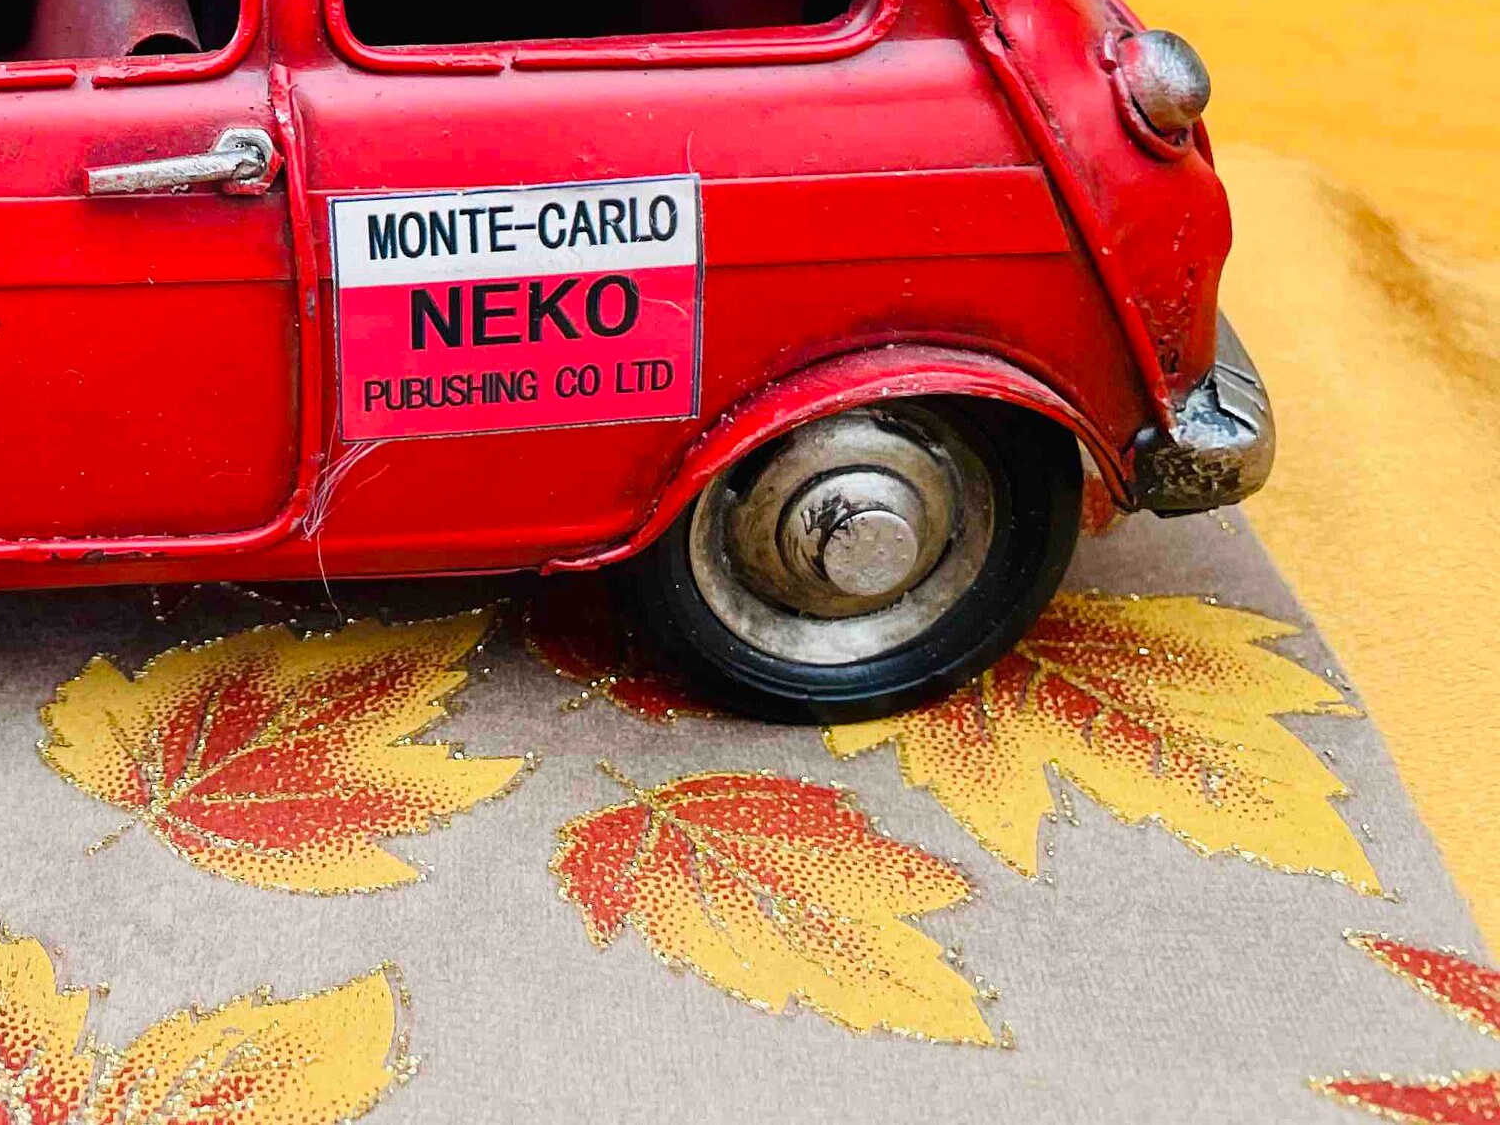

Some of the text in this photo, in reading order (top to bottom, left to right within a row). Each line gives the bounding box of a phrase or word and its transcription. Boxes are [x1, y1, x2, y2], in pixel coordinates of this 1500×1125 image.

[368, 195, 678, 261] MONTE-CARLO
[410, 274, 639, 350] NEKO
[555, 364, 601, 399] CO
[615, 359, 674, 394] LTD
